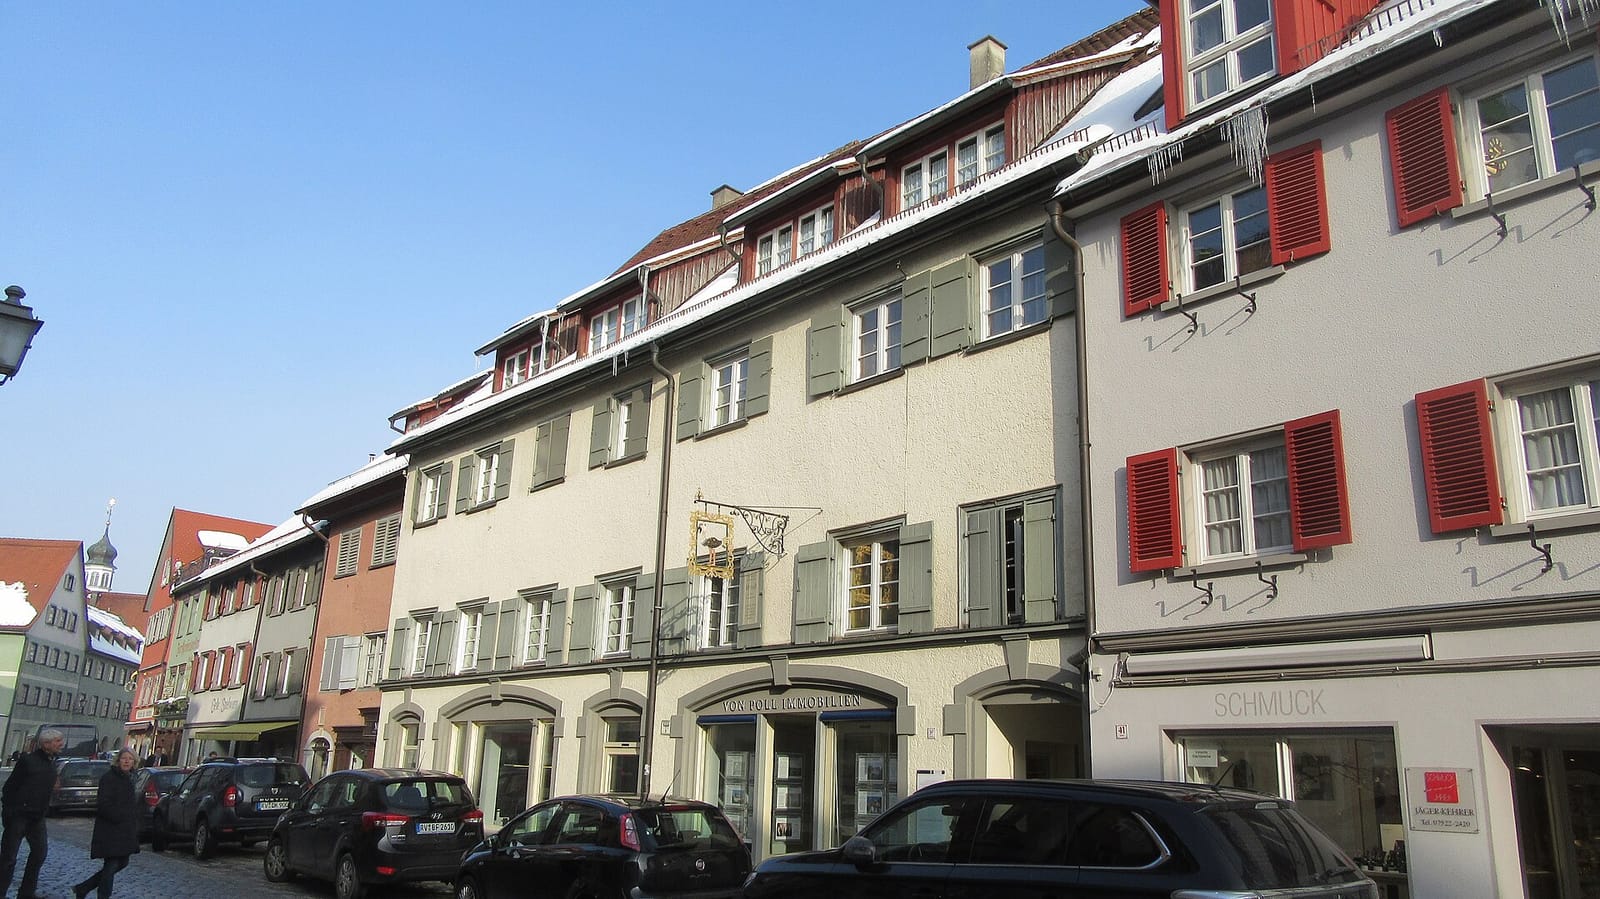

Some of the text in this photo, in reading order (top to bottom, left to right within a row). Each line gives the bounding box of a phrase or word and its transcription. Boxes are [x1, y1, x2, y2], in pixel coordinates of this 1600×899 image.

[722, 694, 861, 712] VON POLL IMMOBILIEN
[1214, 688, 1327, 717] SCHMUCK
